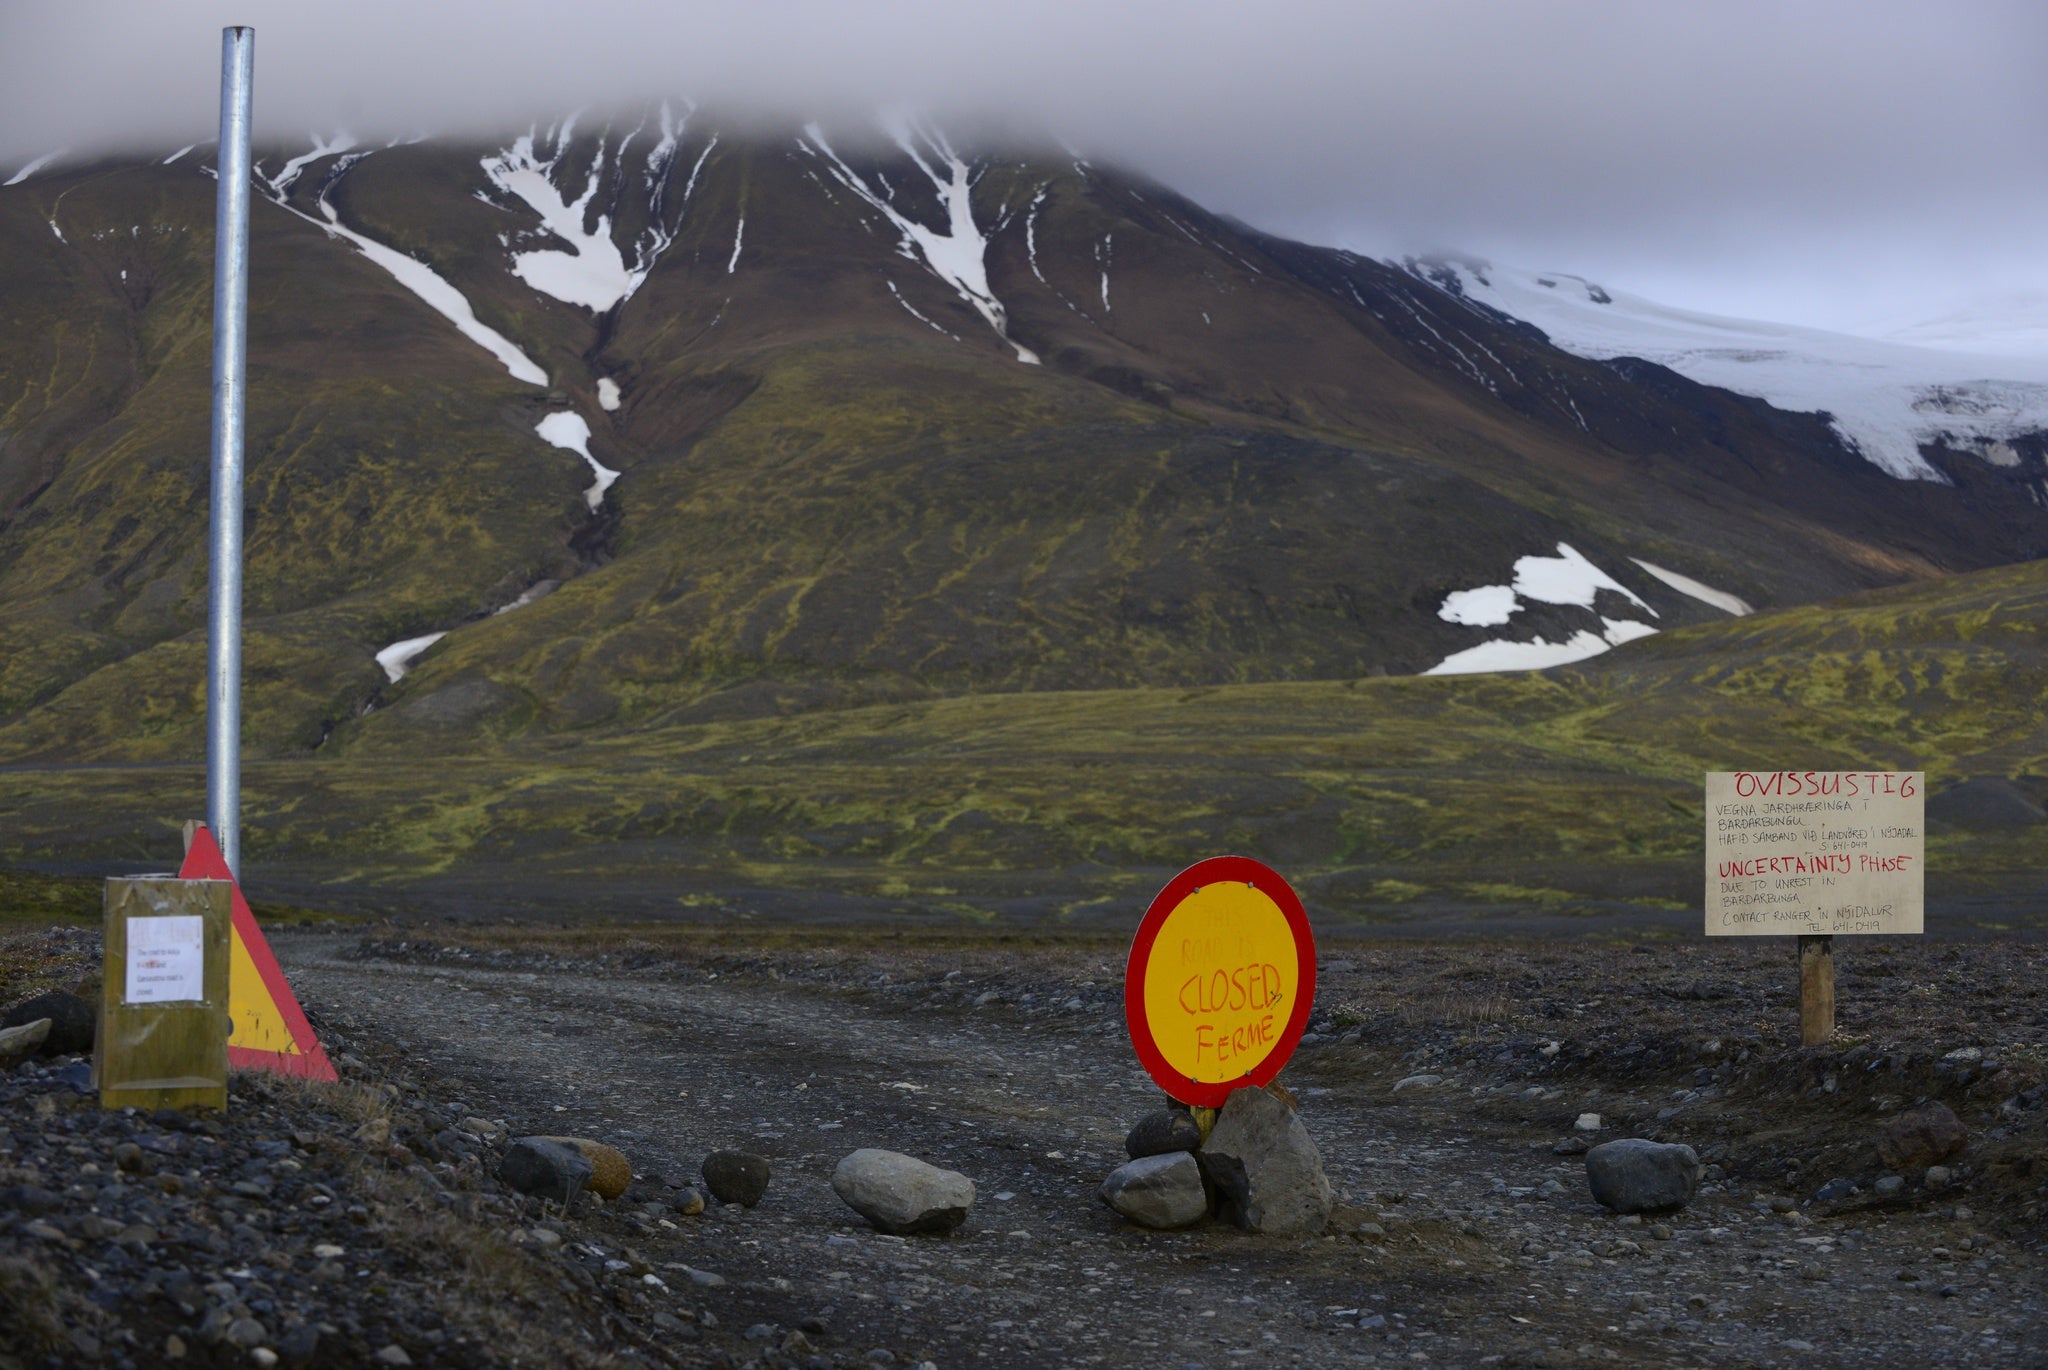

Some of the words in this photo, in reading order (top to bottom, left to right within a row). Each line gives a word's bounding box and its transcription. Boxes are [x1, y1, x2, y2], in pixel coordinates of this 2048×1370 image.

[1715, 803, 1757, 816] VEGNA
[1752, 831, 1798, 844] SAMBAND
[1719, 854, 1852, 878] UNCERTAINTY
[1859, 855, 1913, 872] PHASE
[1720, 881, 1744, 893] DUE
[1751, 879, 1767, 891] TO
[1775, 877, 1815, 890] UNREST
[1722, 912, 1768, 926] CONTACT
[1773, 909, 1813, 922] RANGER
[1832, 920, 1880, 932] 641-0419
[1179, 963, 1282, 1015] CLOSED
[1196, 1014, 1274, 1063] FERME
